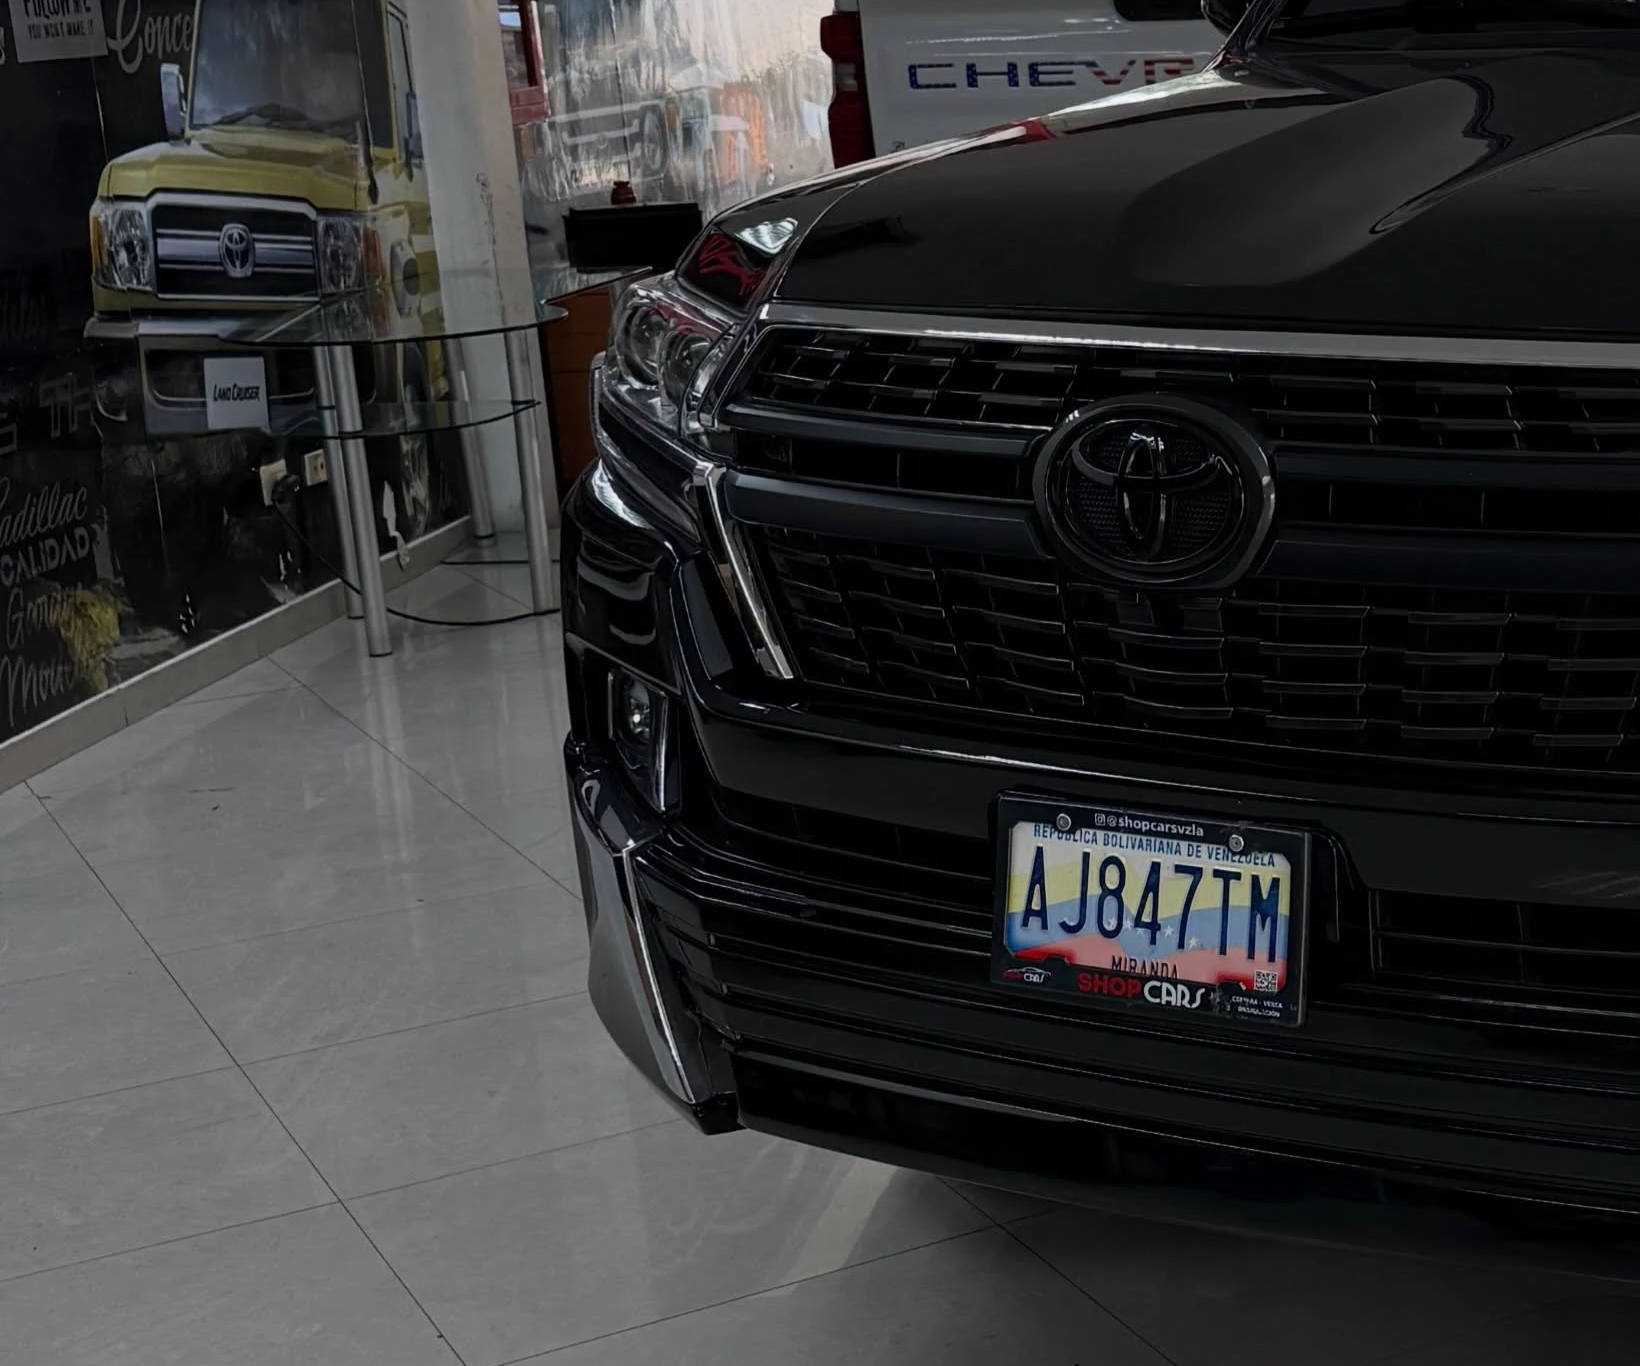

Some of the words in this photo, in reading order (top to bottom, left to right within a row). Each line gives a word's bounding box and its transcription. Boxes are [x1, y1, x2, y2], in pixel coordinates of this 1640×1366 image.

[0, 526, 90, 588] CALIDAD
[1187, 843, 1202, 859] DE
[1207, 846, 1276, 868] VENEZUELA
[1022, 845, 1281, 963] AJ847TM
[1111, 954, 1180, 980] MIRANDA
[1079, 972, 1143, 999] SHOP
[1144, 980, 1206, 1009] CARS
